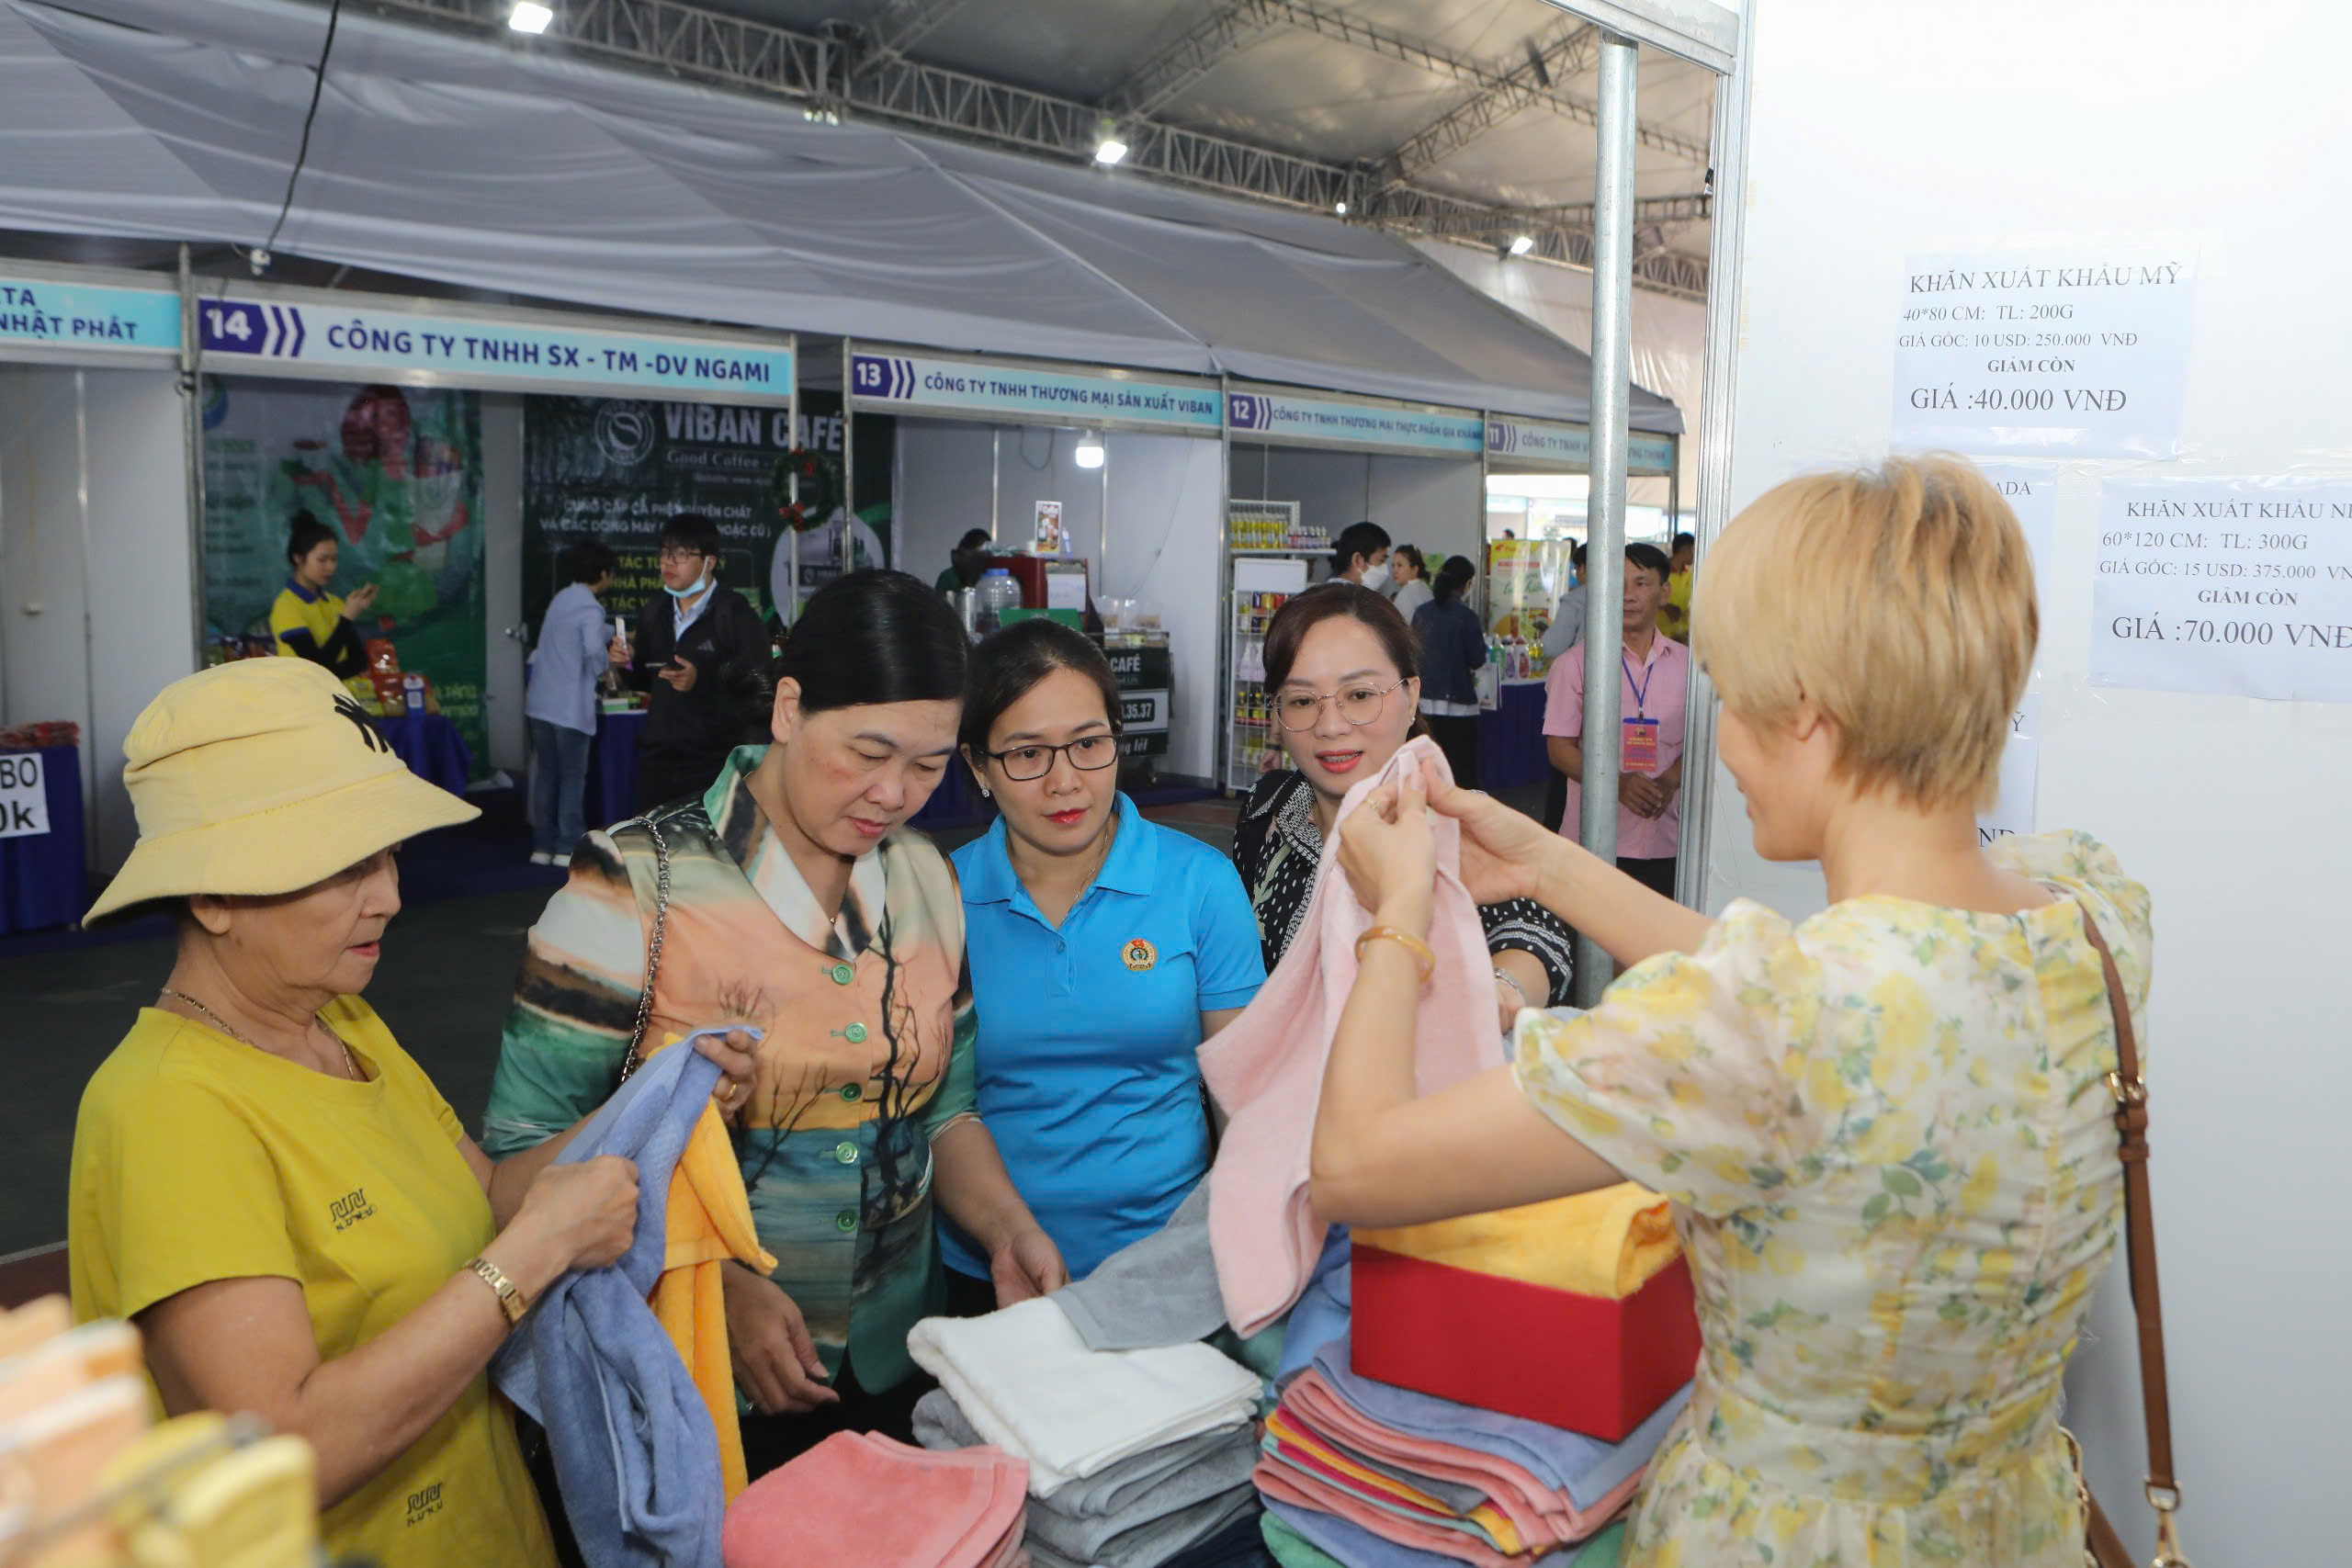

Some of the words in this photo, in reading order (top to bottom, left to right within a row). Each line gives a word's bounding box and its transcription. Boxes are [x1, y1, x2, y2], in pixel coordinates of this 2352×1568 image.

[1910, 268, 1974, 293] KHĂN
[1981, 265, 2052, 288] XUẤT
[2057, 263, 2132, 287] KHẨU
[2139, 261, 2182, 286] MỸ
[0, 286, 36, 307] TA
[1951, 306, 1985, 321] CM:
[1996, 305, 2024, 320] TL:
[2030, 304, 2075, 320] 200G
[205, 309, 253, 342] 14
[328, 318, 412, 354] CÔNG
[421, 334, 455, 357] TY
[464, 337, 539, 365] TNHH
[548, 345, 580, 367] SX
[604, 350, 638, 372] TM
[695, 358, 771, 383] NGAMI
[1899, 331, 1927, 348] GIÁ
[1930, 331, 1968, 348] GỐC:
[1974, 334, 1989, 346] 10
[1995, 333, 2030, 347] USD:
[2035, 333, 2091, 347] 250.000
[2101, 333, 2139, 346] VNĐ
[1987, 355, 2033, 373] GIẢM
[2038, 355, 2076, 373] CÒN
[856, 362, 882, 387] 13
[924, 371, 965, 392] CÔNG
[968, 379, 987, 394] TY
[990, 382, 1028, 398] TNHH
[1031, 384, 1088, 403] THƯƠNG
[1091, 391, 1114, 410] MẠI
[1145, 390, 1175, 412] XUẤT
[1179, 400, 1213, 414] VIBAN
[1910, 382, 1960, 410] GIÁ
[1968, 389, 2054, 411] :40.000
[2064, 389, 2128, 412] VNĐ
[1232, 400, 1250, 420] 12
[1273, 406, 1301, 422] CÔNG
[1301, 412, 1312, 423] TY
[664, 404, 761, 446] VIBAN
[772, 411, 842, 452] CAFÉ
[1521, 431, 1545, 449] CÔNG
[1546, 436, 1557, 450] TY
[667, 449, 707, 465] Good
[712, 452, 760, 468] Coffee
[2127, 500, 2187, 517] KHĂN
[2192, 499, 2253, 518] XUẤT
[2258, 498, 2324, 519] KHẨU
[2170, 533, 2208, 549] CM:
[2221, 534, 2252, 549] TL:
[2258, 534, 2309, 550] 300G
[2099, 558, 2130, 574] GIÁ
[2135, 558, 2177, 576] GỐC:
[2184, 564, 2200, 576] 15
[2207, 564, 2248, 578] USD:
[2253, 564, 2316, 579] 375.000
[2327, 566, 2352, 580] VN
[2198, 586, 2250, 604] GIẢM
[2256, 588, 2298, 606] CÒN
[2111, 611, 2165, 641] GIÁ
[2176, 619, 2274, 645] :70.000
[2285, 624, 2352, 649] VNĐ
[1110, 653, 1141, 672] CAFÉ
